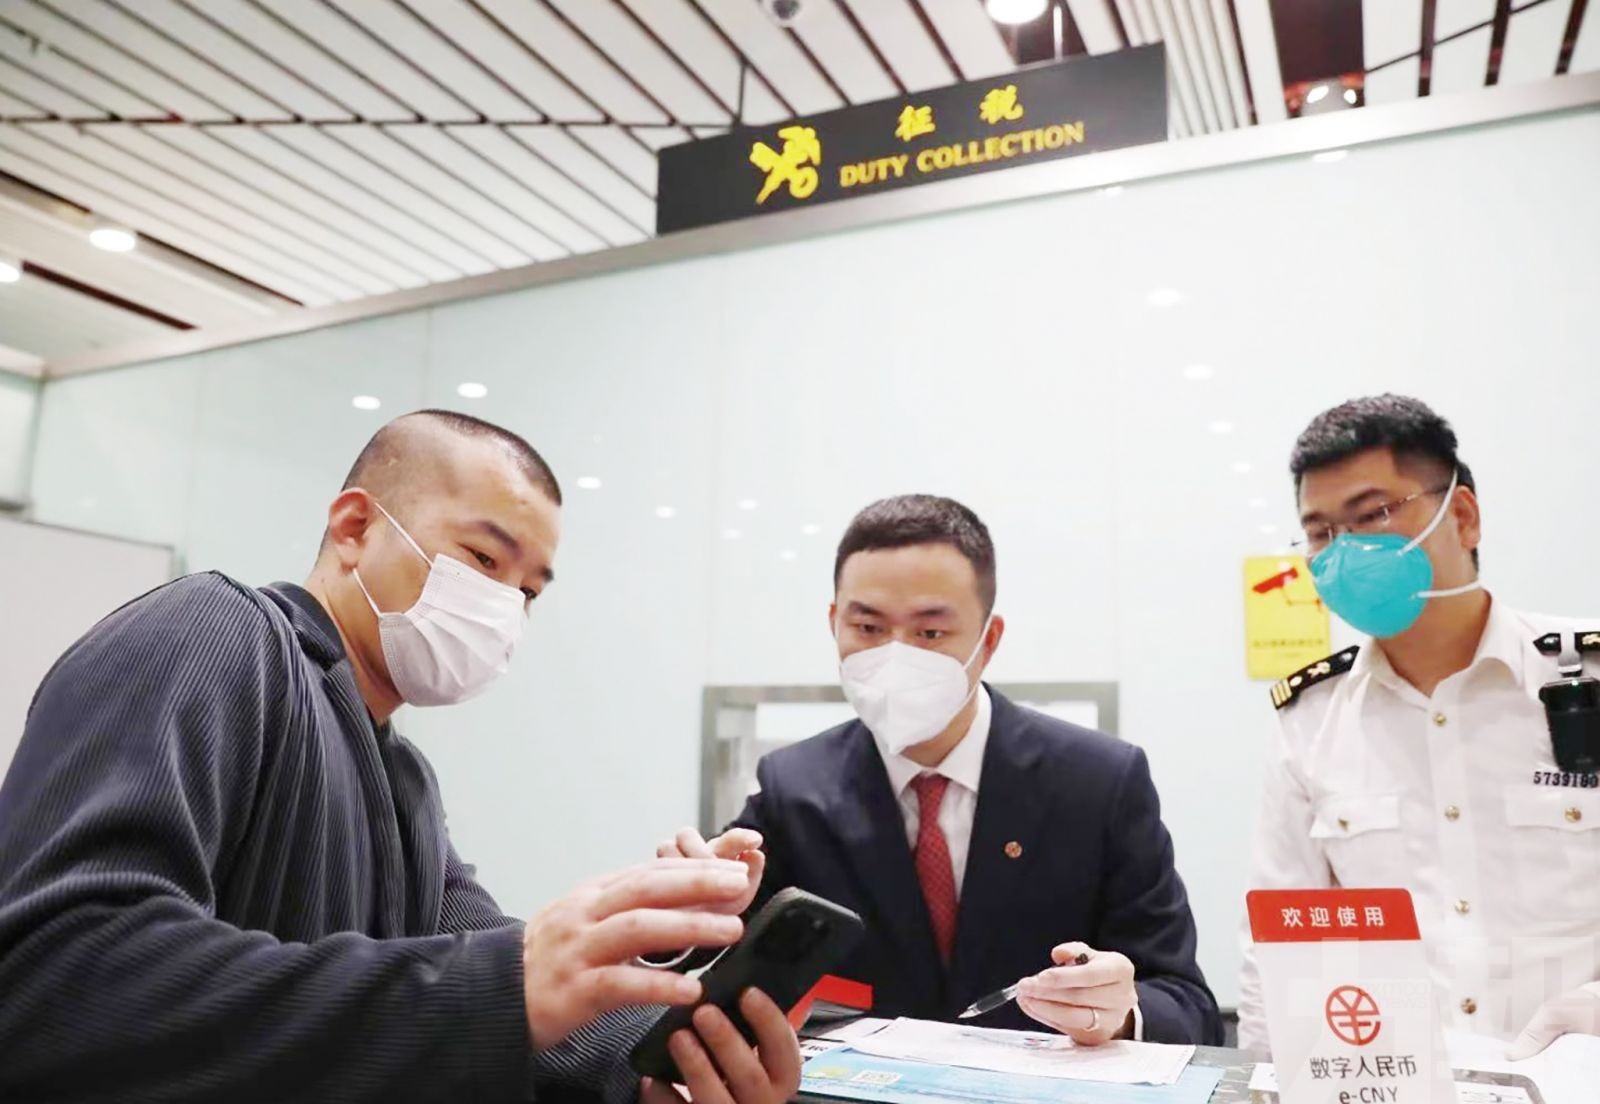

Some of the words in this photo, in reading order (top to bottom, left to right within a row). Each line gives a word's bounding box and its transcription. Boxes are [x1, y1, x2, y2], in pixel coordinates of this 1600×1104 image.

[839, 154, 909, 188] DUTY
[915, 121, 1085, 173] COLLECTION
[1280, 905, 1385, 928] 欢迎使用
[1309, 1054, 1417, 1080] 数字人民币
[1338, 1086, 1398, 1104] e-CNY
